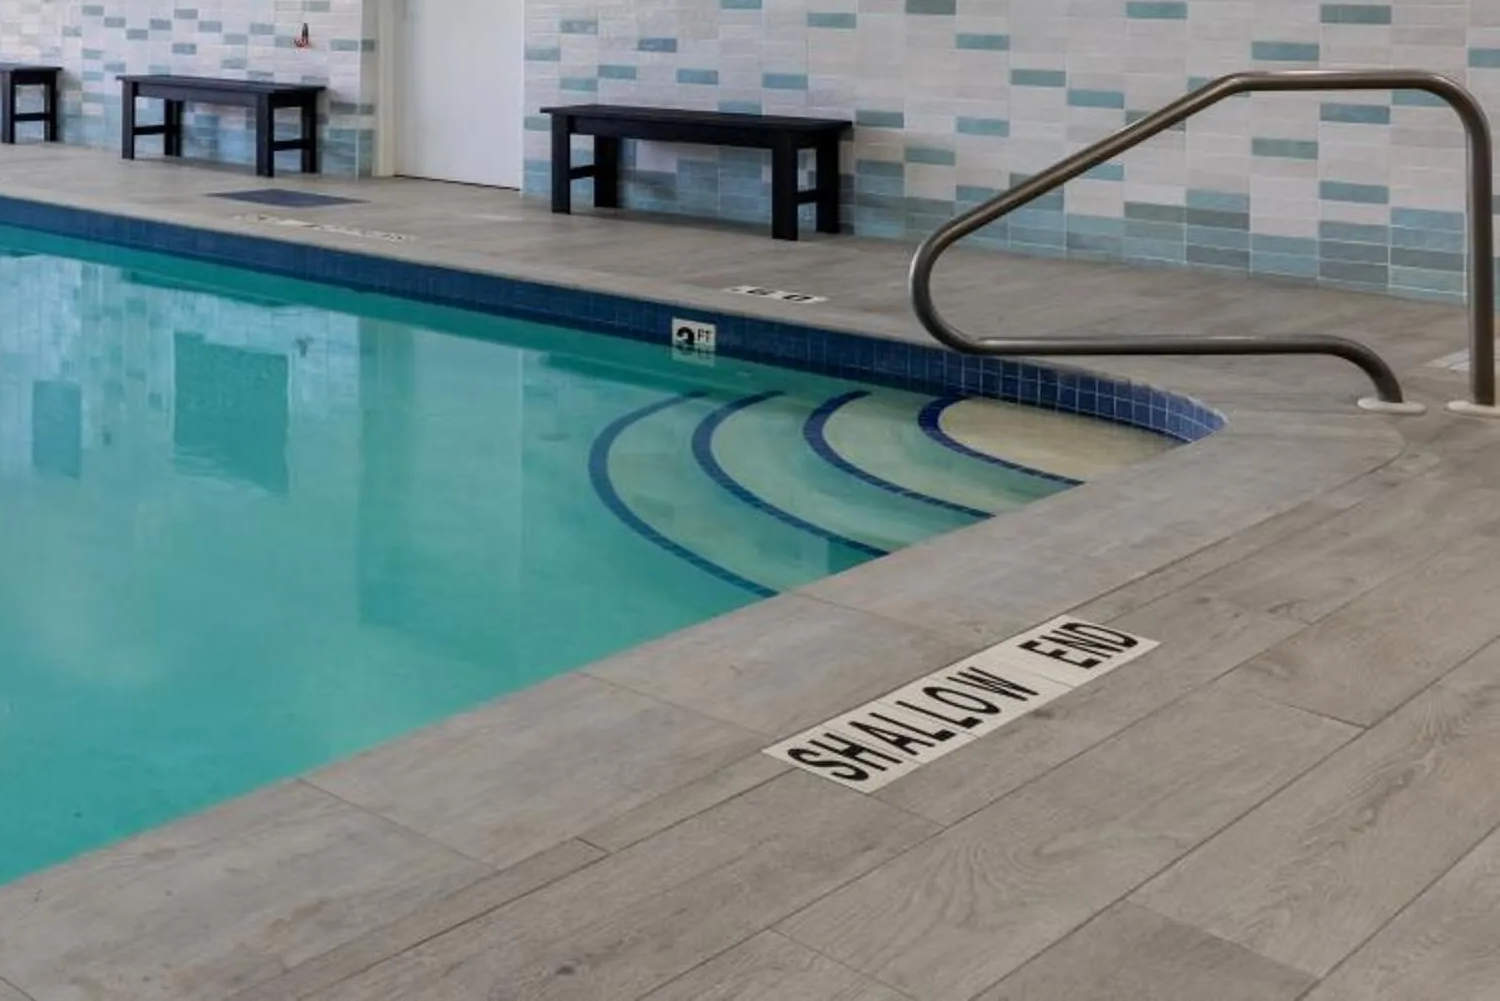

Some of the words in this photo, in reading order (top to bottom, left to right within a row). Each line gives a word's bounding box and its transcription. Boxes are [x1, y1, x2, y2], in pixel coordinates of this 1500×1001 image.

[697, 328, 710, 343] FT
[787, 666, 1040, 782] SHALLOW
[1017, 621, 1140, 670] END
